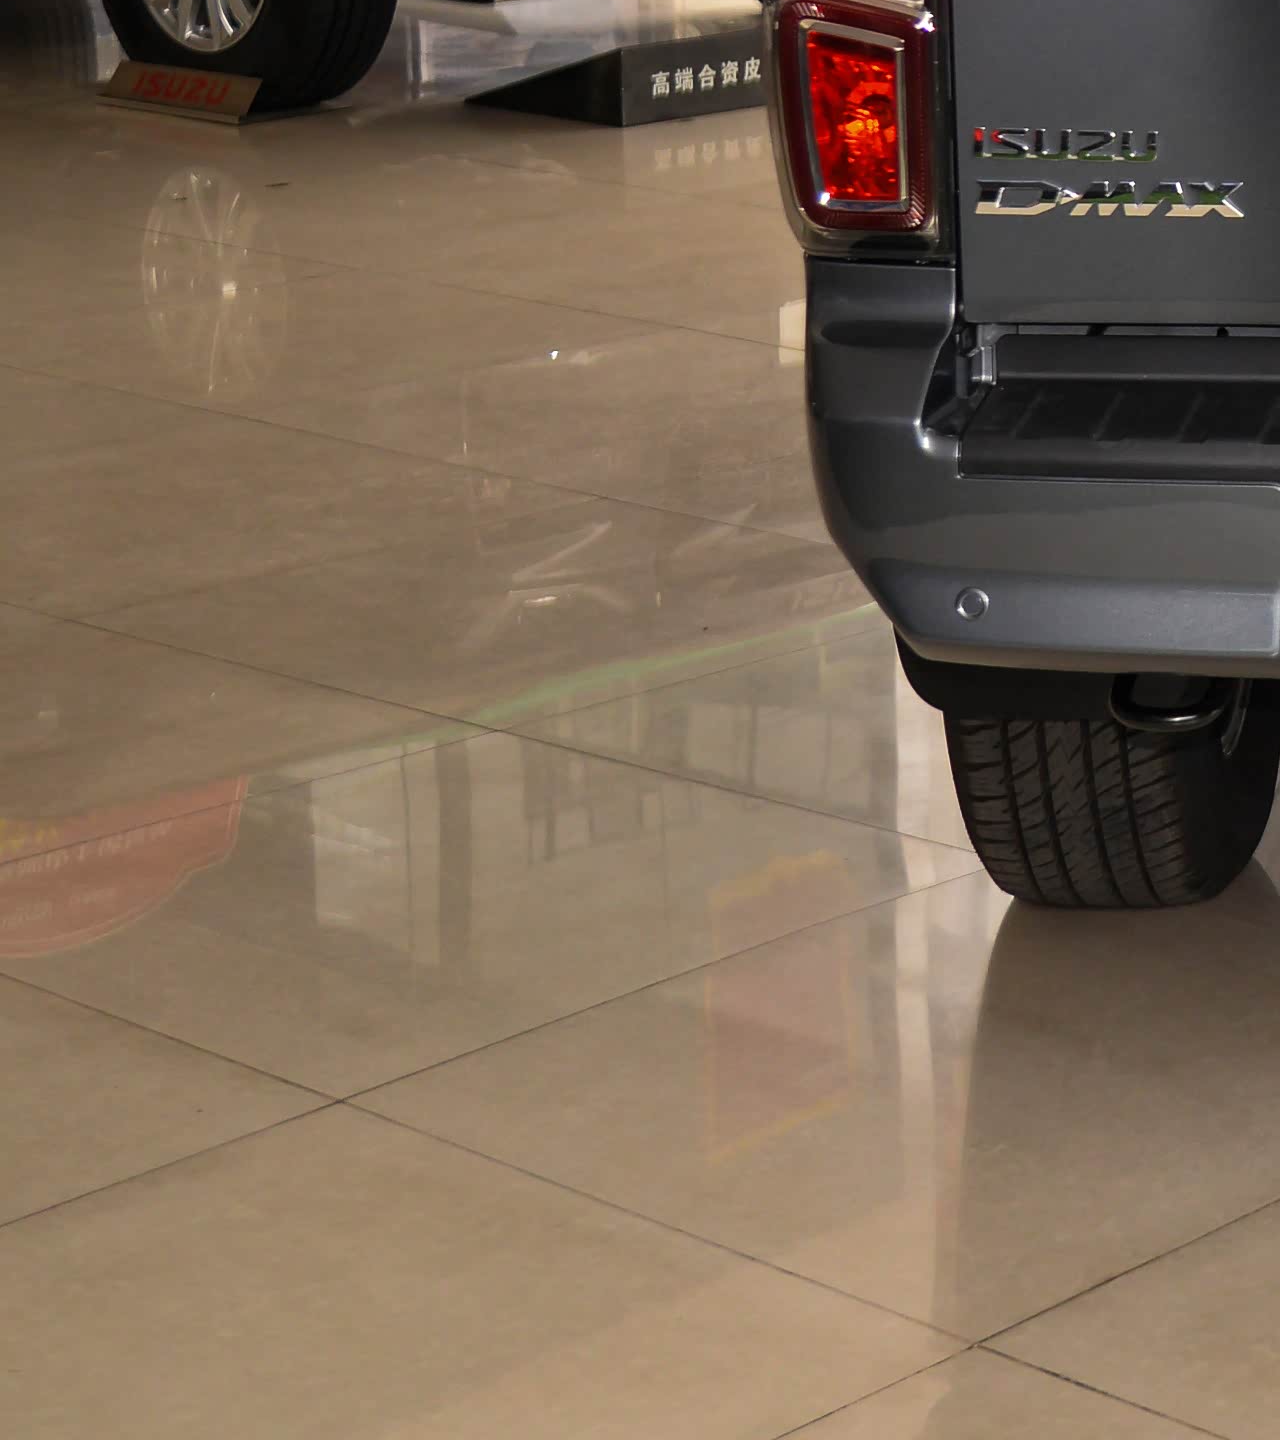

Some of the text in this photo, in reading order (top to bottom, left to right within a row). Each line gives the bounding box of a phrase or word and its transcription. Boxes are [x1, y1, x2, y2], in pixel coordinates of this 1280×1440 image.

[129, 68, 233, 107] ISUZU
[651, 56, 762, 98] 高端合资皮
[973, 127, 1159, 162] ISUZU
